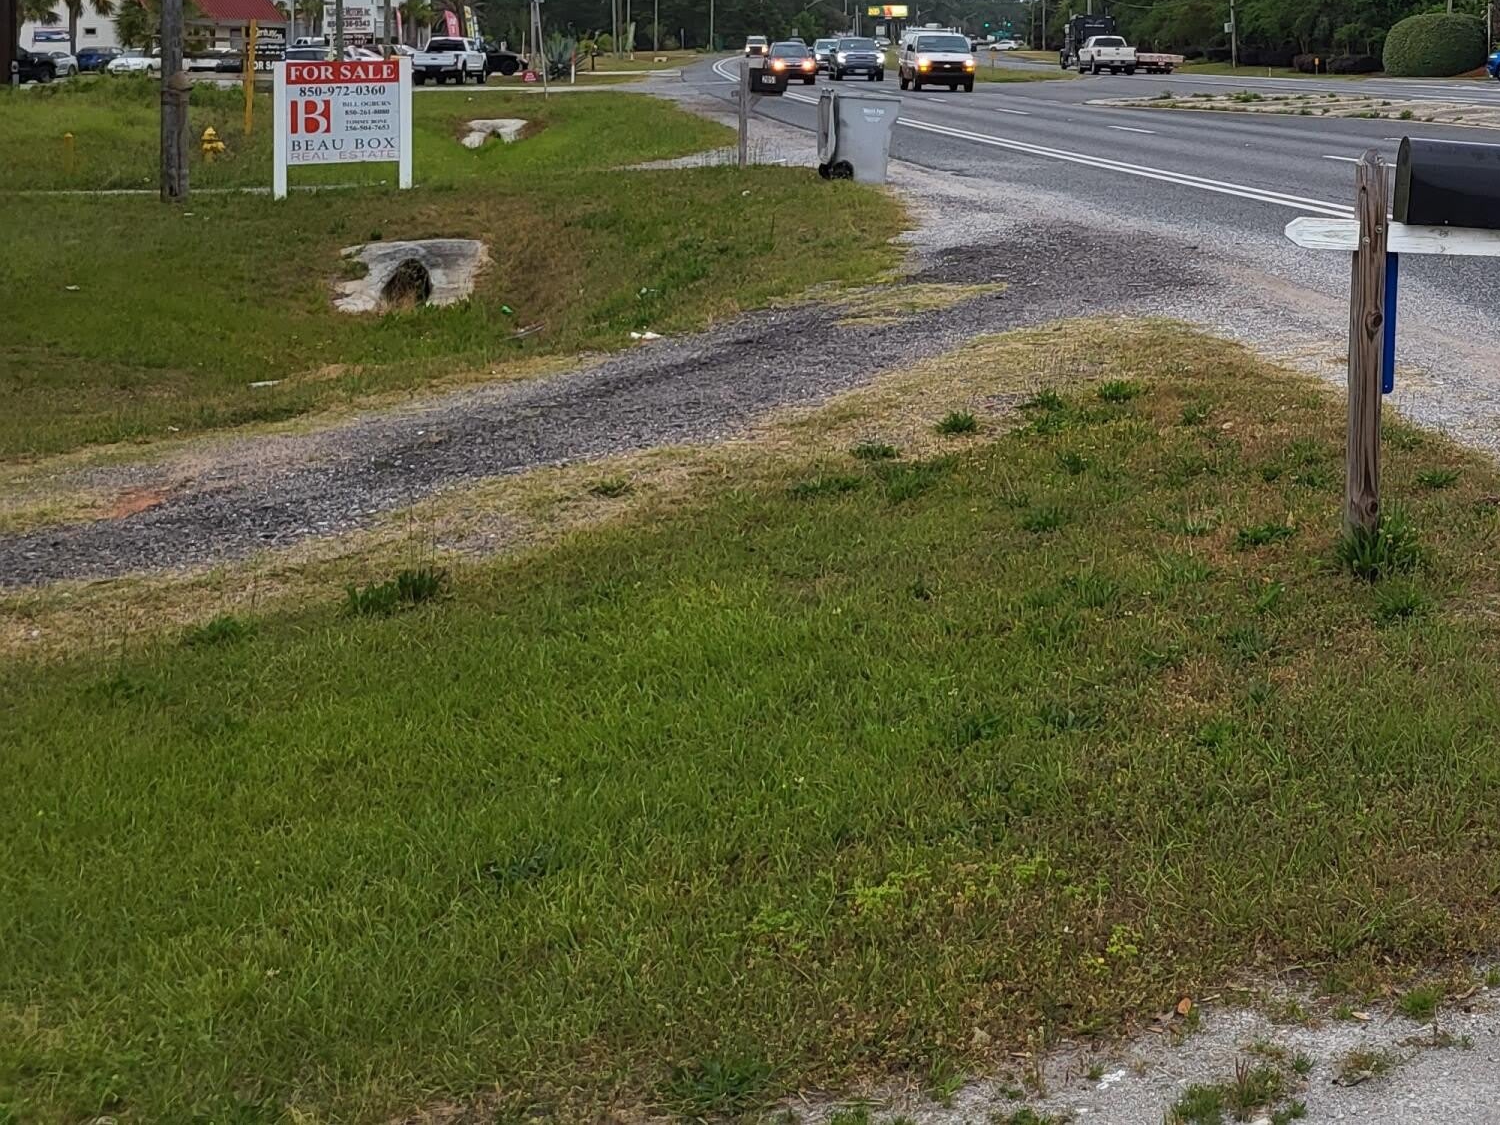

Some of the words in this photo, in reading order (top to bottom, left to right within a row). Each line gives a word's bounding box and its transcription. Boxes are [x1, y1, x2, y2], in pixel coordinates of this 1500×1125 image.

[290, 66, 334, 81] FOR
[340, 64, 395, 79] SALE
[299, 85, 386, 97] 850-972-0360
[291, 139, 344, 152] BEAU
[355, 137, 395, 150] BOX
[290, 152, 329, 161] REAL
[338, 150, 396, 160] ESTATE
